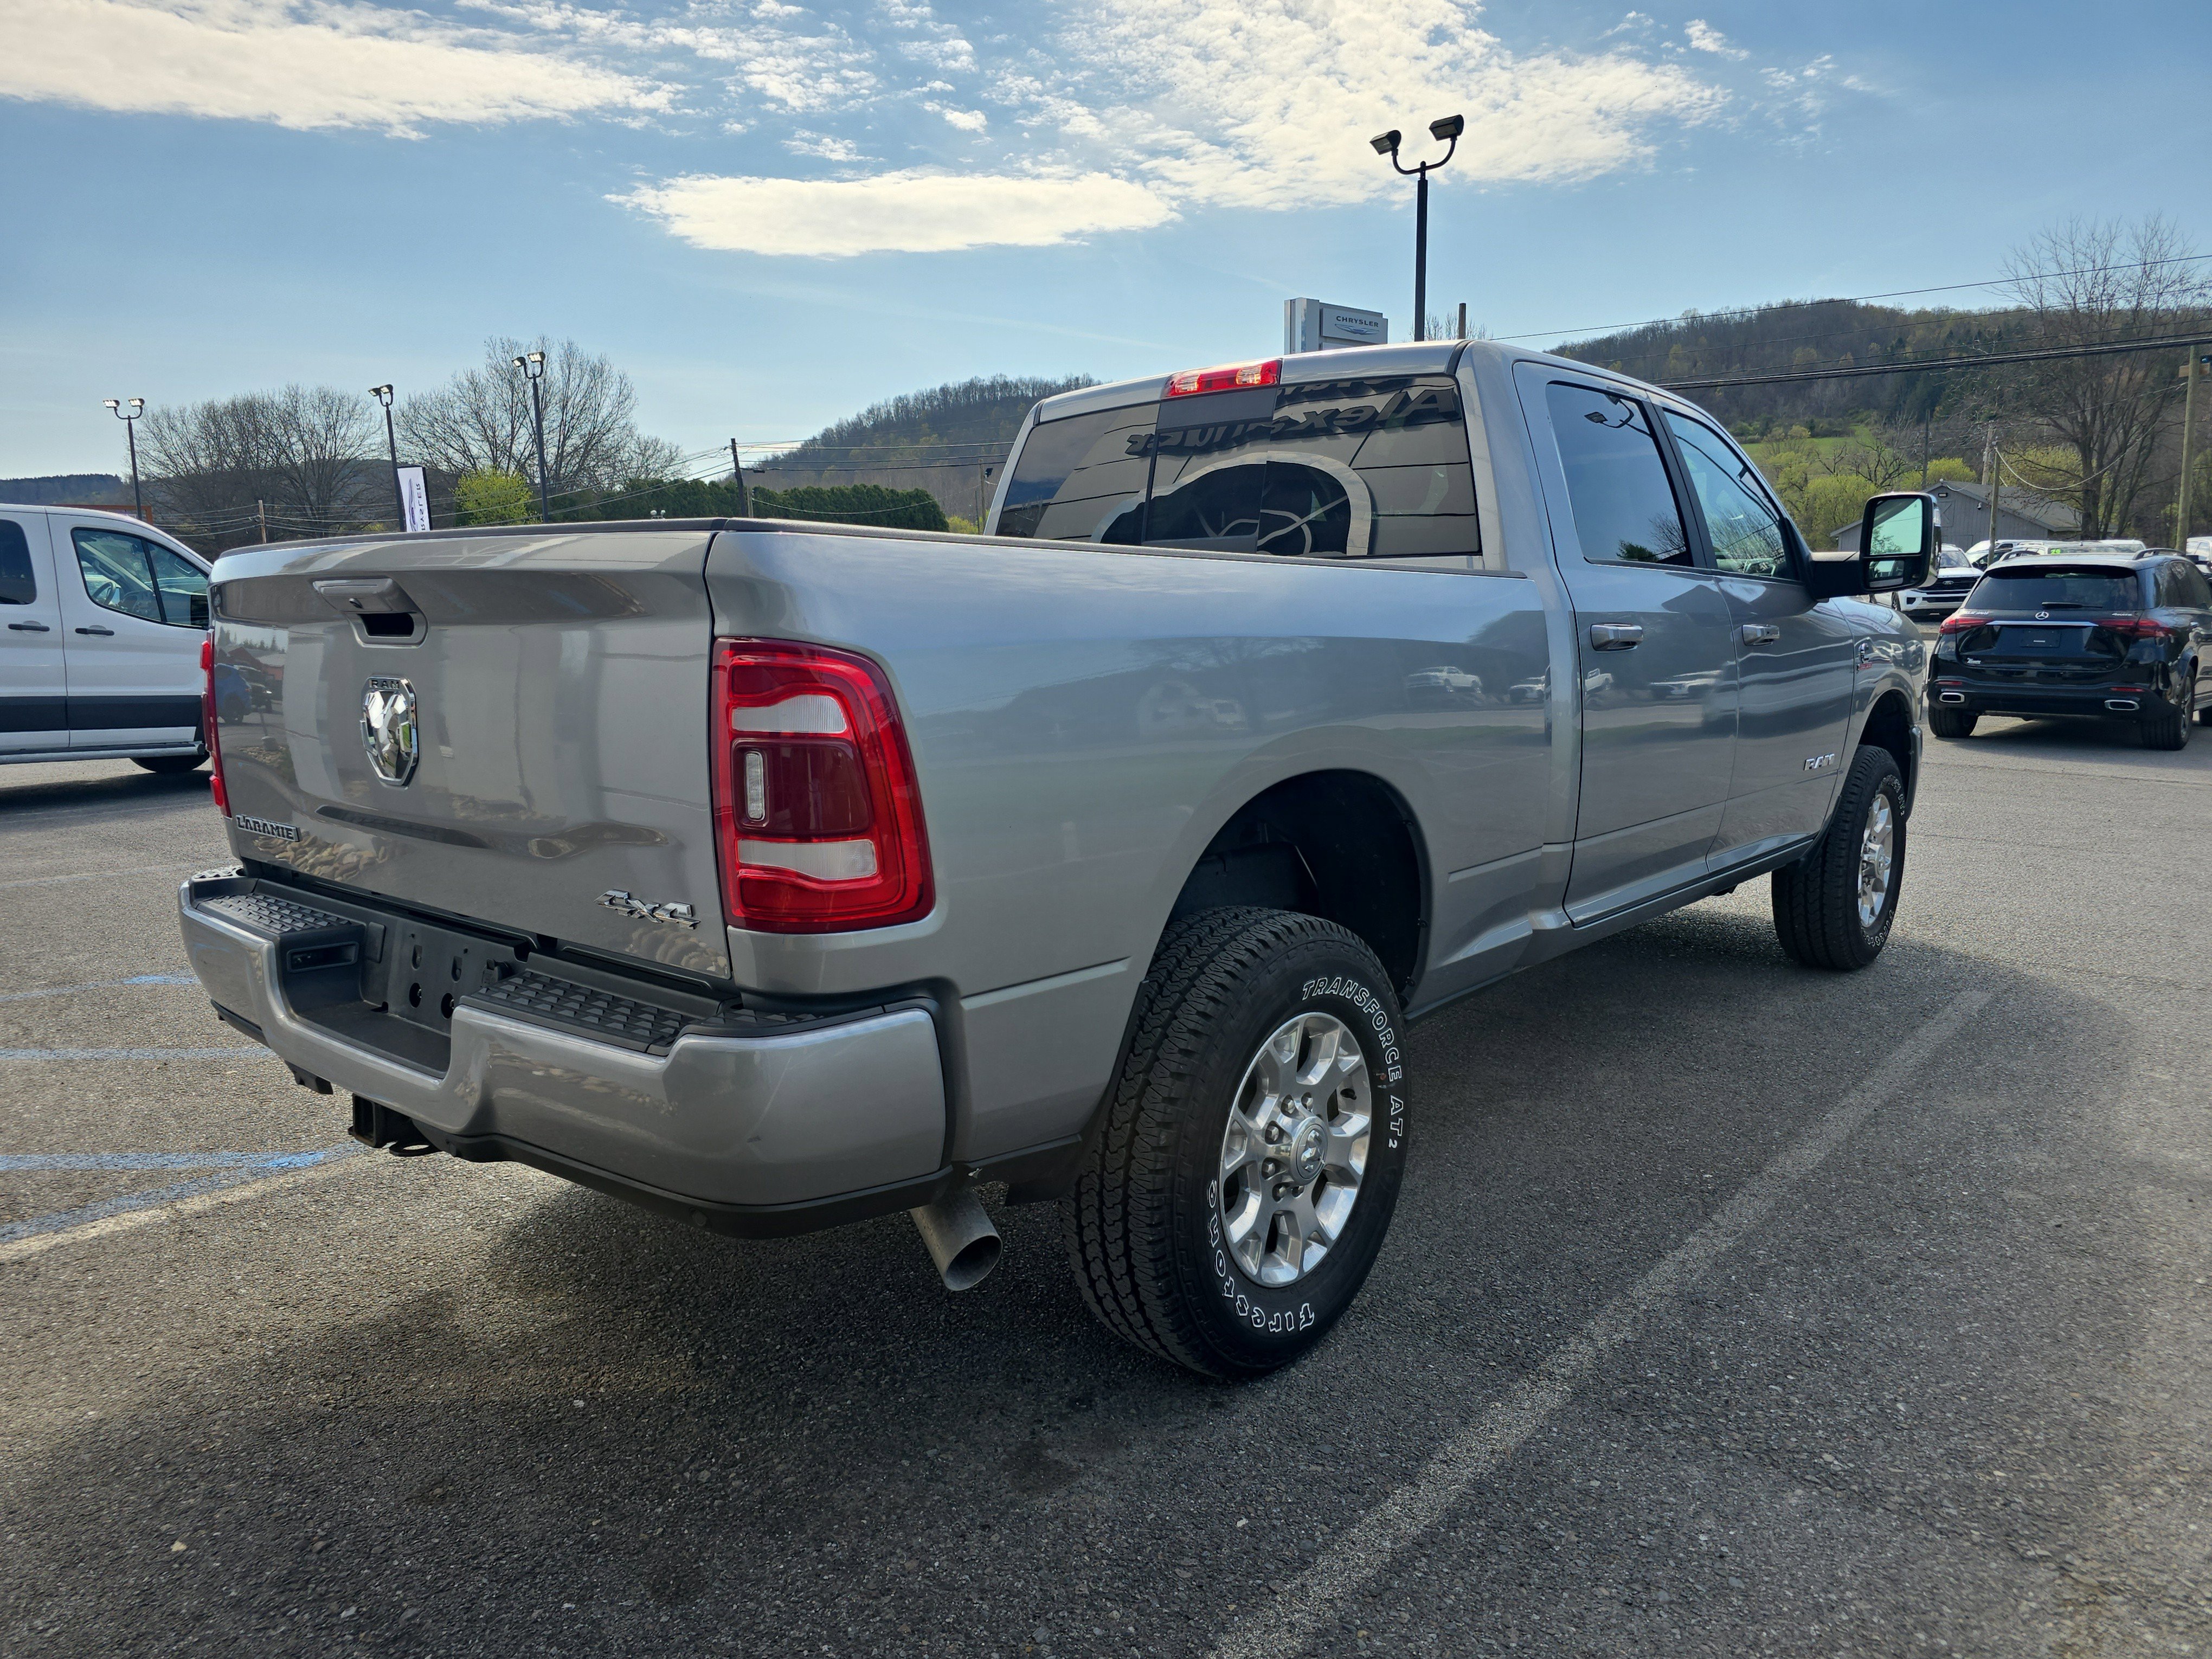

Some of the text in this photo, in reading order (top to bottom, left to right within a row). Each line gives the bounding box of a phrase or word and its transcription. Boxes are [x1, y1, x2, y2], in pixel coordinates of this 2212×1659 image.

[1336, 316, 1379, 327] CHRYSLER
[369, 679, 401, 690] RAM
[1803, 753, 1835, 771] RAM
[236, 814, 298, 841] LARAMIE
[1302, 976, 1403, 1082] TRANSFORCE
